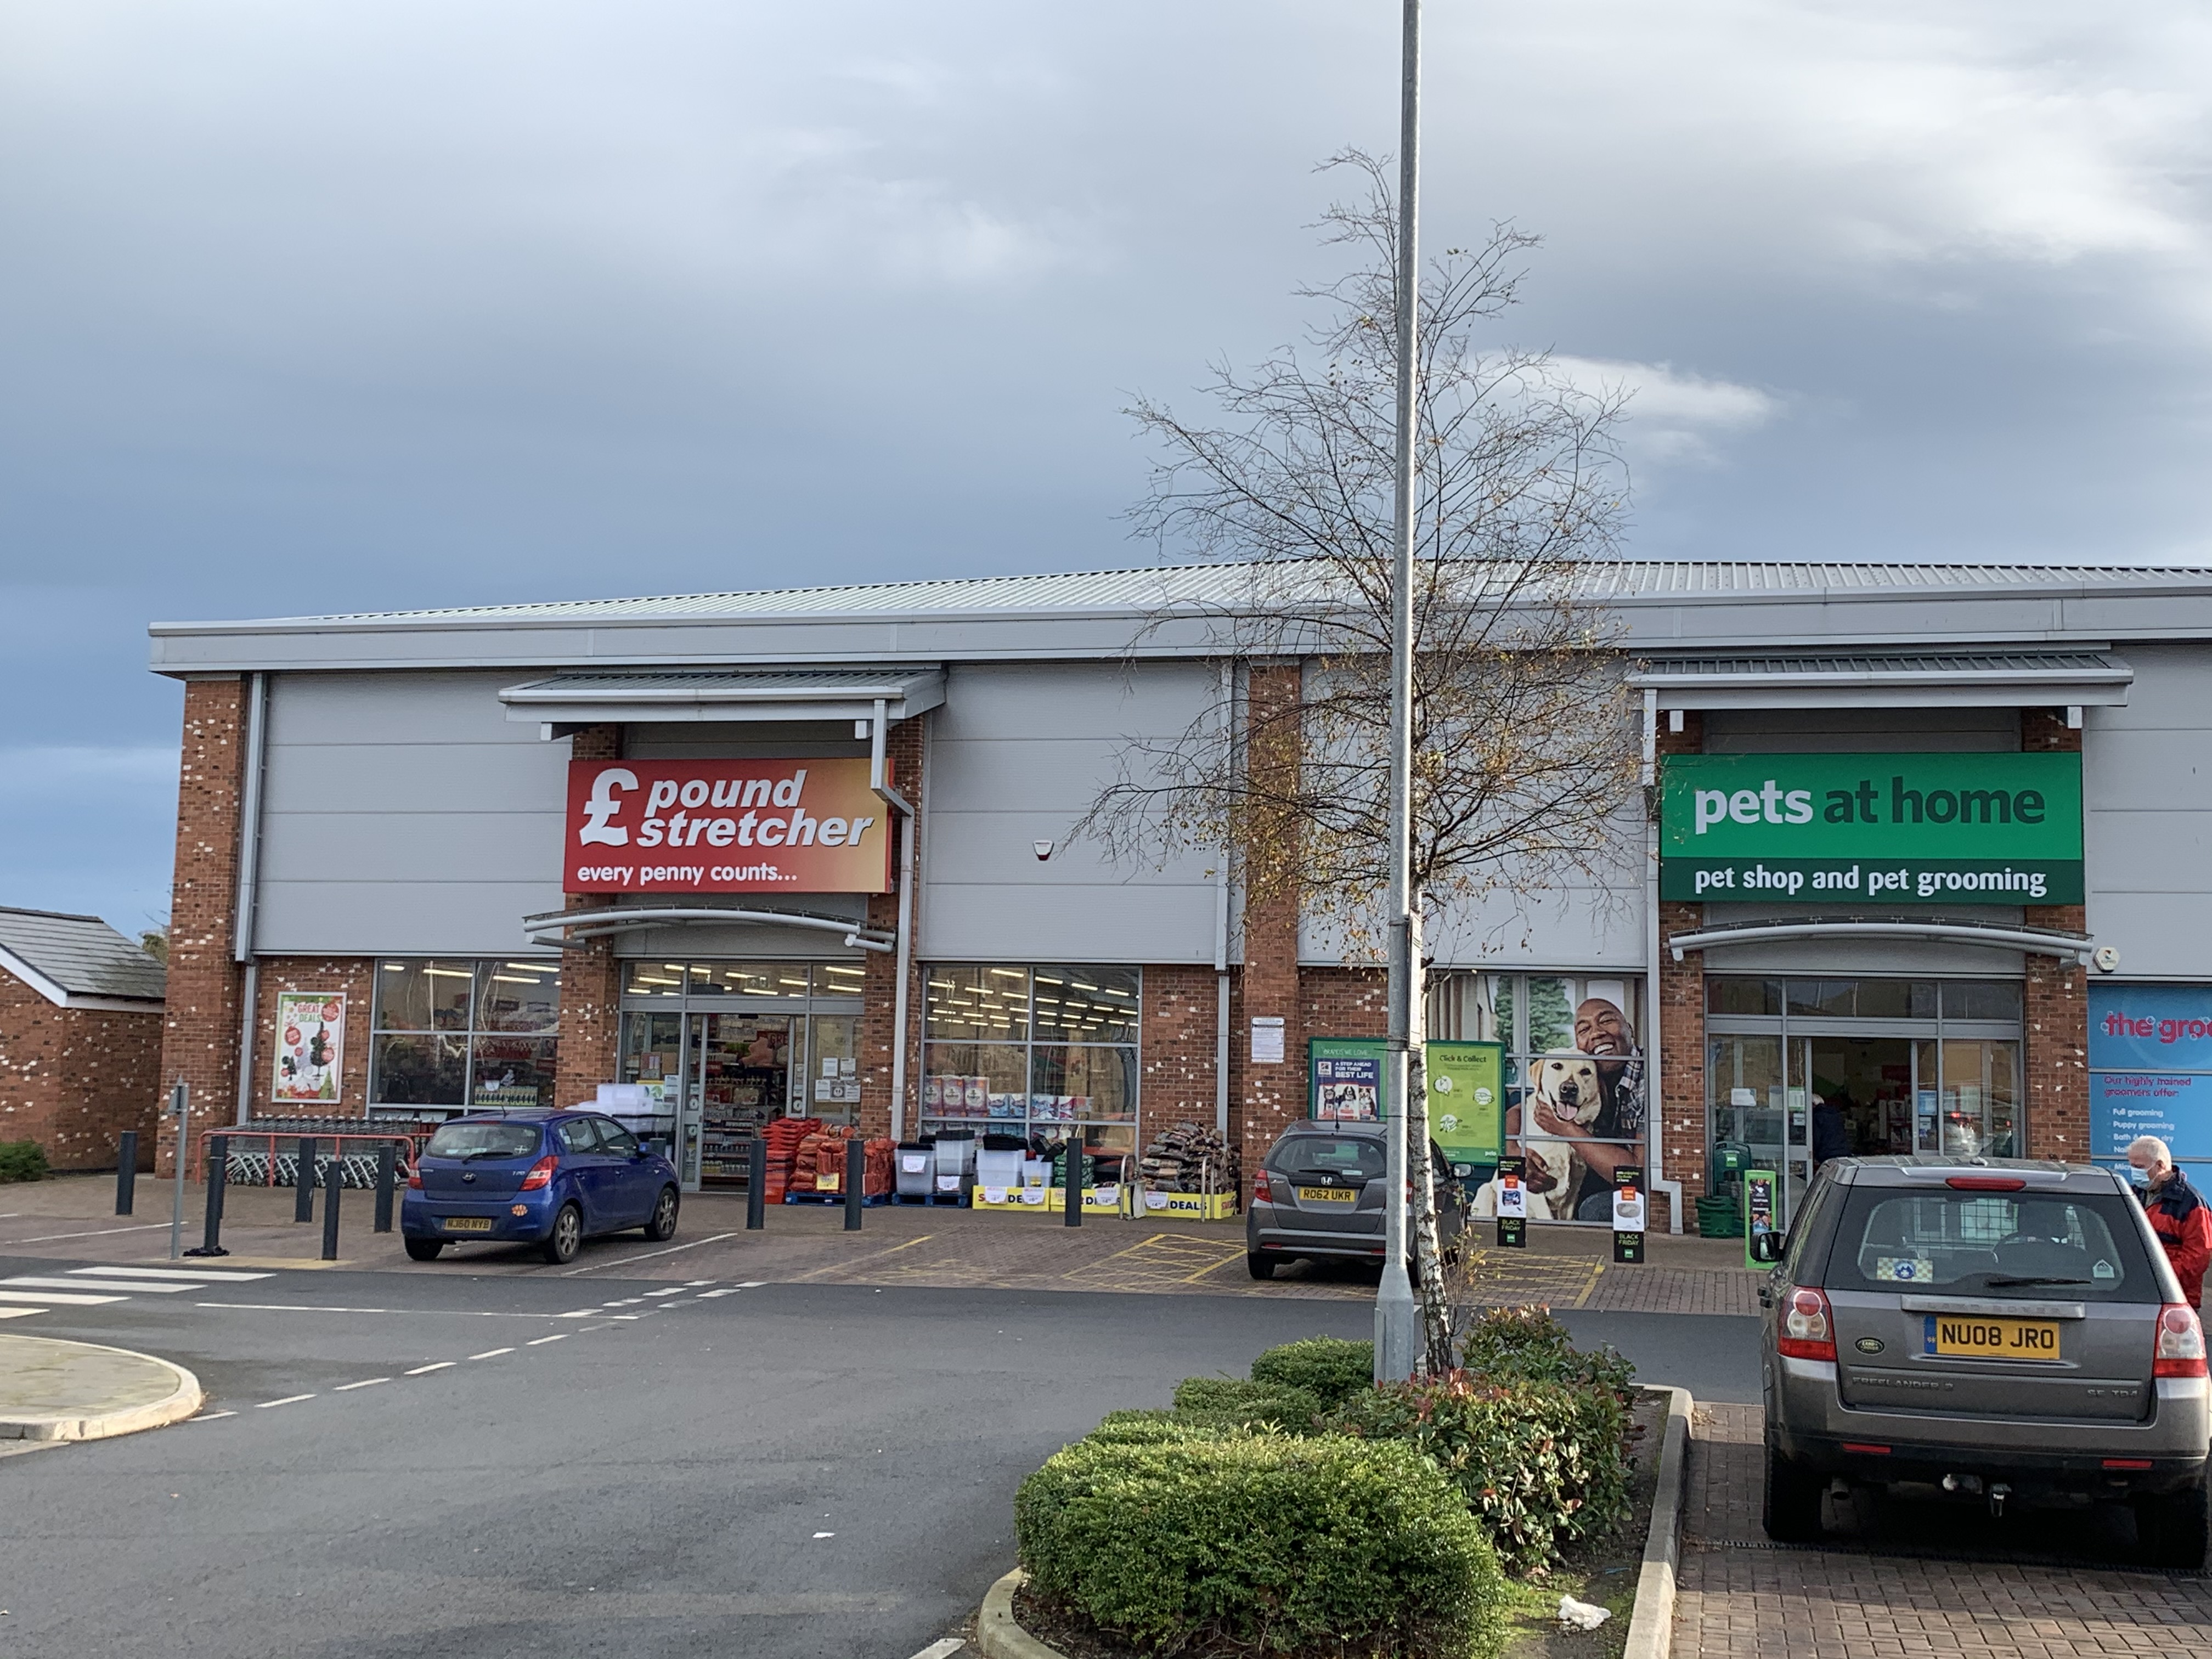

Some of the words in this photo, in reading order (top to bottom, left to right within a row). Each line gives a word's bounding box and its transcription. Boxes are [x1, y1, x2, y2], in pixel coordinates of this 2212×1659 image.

[644, 770, 808, 817] pound
[1695, 780, 1813, 834] pets
[1824, 780, 1878, 823] at
[1892, 776, 2045, 824] home
[636, 808, 874, 848] stretcher
[577, 866, 634, 886] every
[640, 866, 704, 886] penny
[710, 862, 798, 881] counts...
[1695, 867, 1735, 894] pet
[1743, 864, 1804, 895] shop
[1812, 865, 1859, 889] and
[1868, 868, 1910, 896] pet
[1917, 867, 2047, 898] grooming
[298, 1004, 320, 1013] GREAT
[300, 1014, 321, 1023] DEALS
[2105, 1012, 2154, 1037] the
[2104, 1076, 2121, 1085] Our
[2125, 1076, 2154, 1087] highly
[2157, 1076, 2192, 1086] trained
[2104, 1088, 2151, 1098] groomers
[2113, 1108, 2126, 1116] Full
[2127, 1109, 2164, 1118] grooming
[2113, 1121, 2137, 1130] Puppy
[2138, 1122, 2175, 1131] grooming
[1331, 1190, 1351, 1200] UKR
[1942, 1324, 2001, 1346] NU08
[2010, 1328, 2055, 1349] JRO
[1853, 1377, 1939, 1389] FREELANDER
